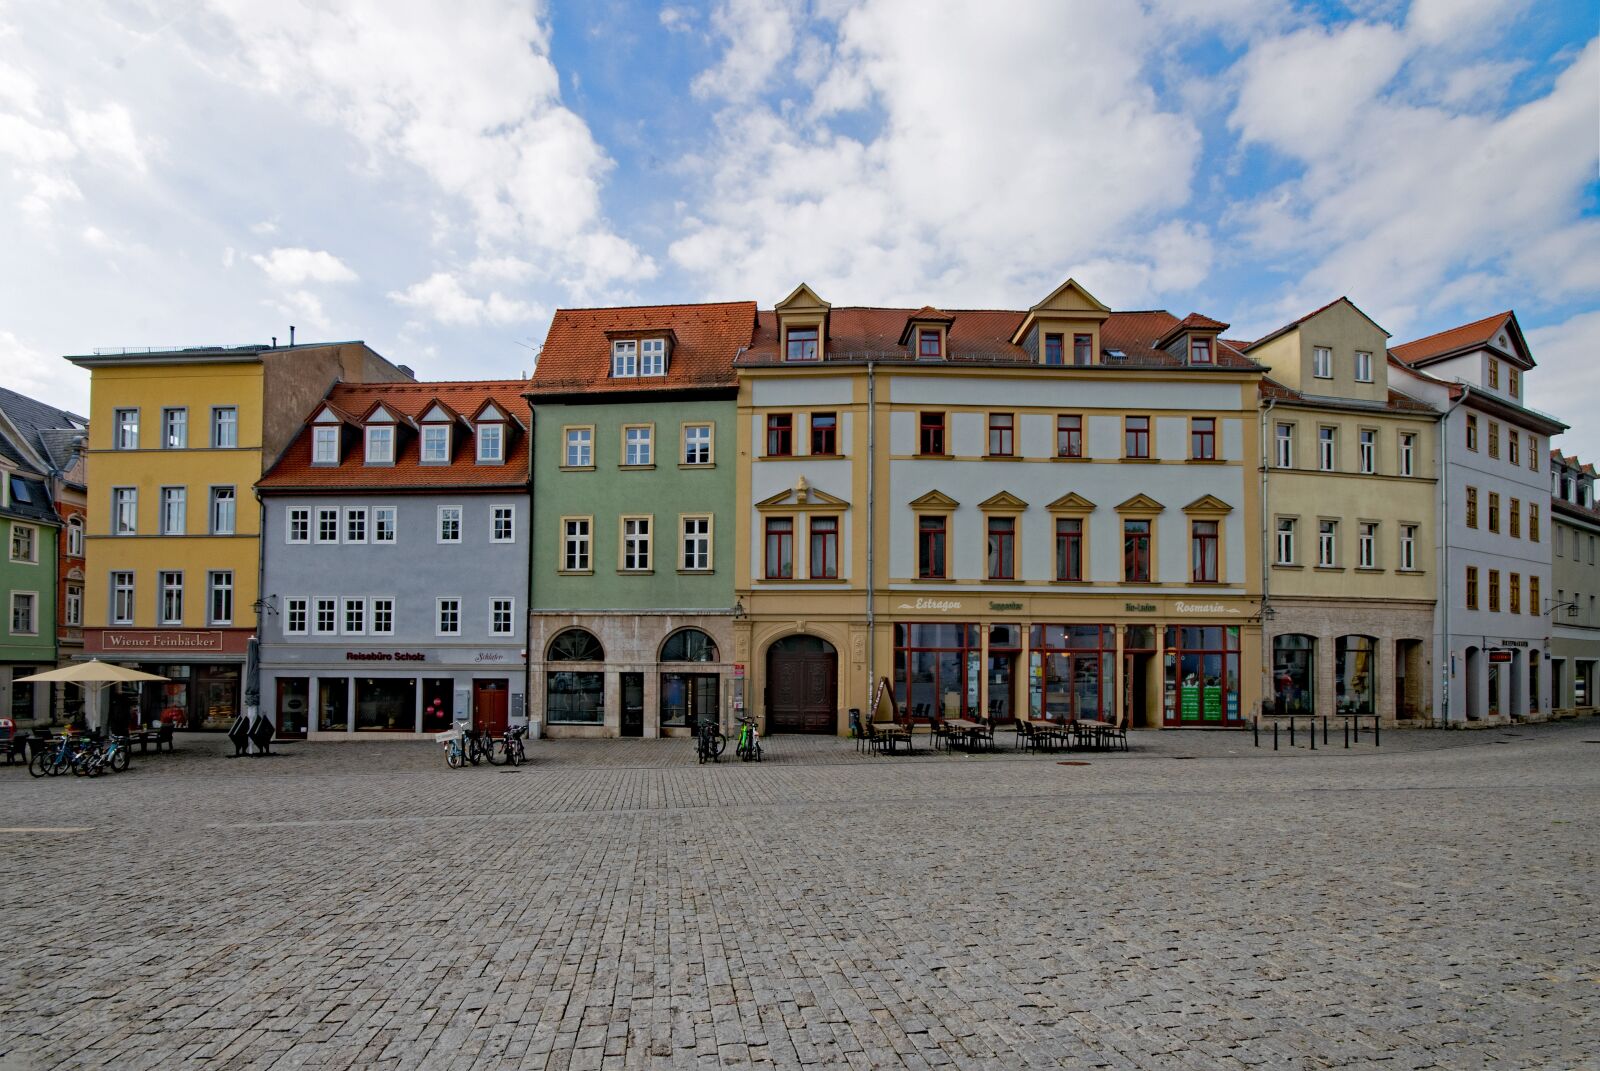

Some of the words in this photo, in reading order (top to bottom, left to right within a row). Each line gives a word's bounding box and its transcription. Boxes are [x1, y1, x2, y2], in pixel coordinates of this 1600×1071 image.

[916, 598, 961, 611] Estragon
[1175, 601, 1224, 612] Rosmarin
[110, 635, 150, 646] Wiener
[153, 634, 215, 646] Feinbäcker
[346, 651, 392, 660] Reisebüro
[394, 651, 426, 660] Scholz
